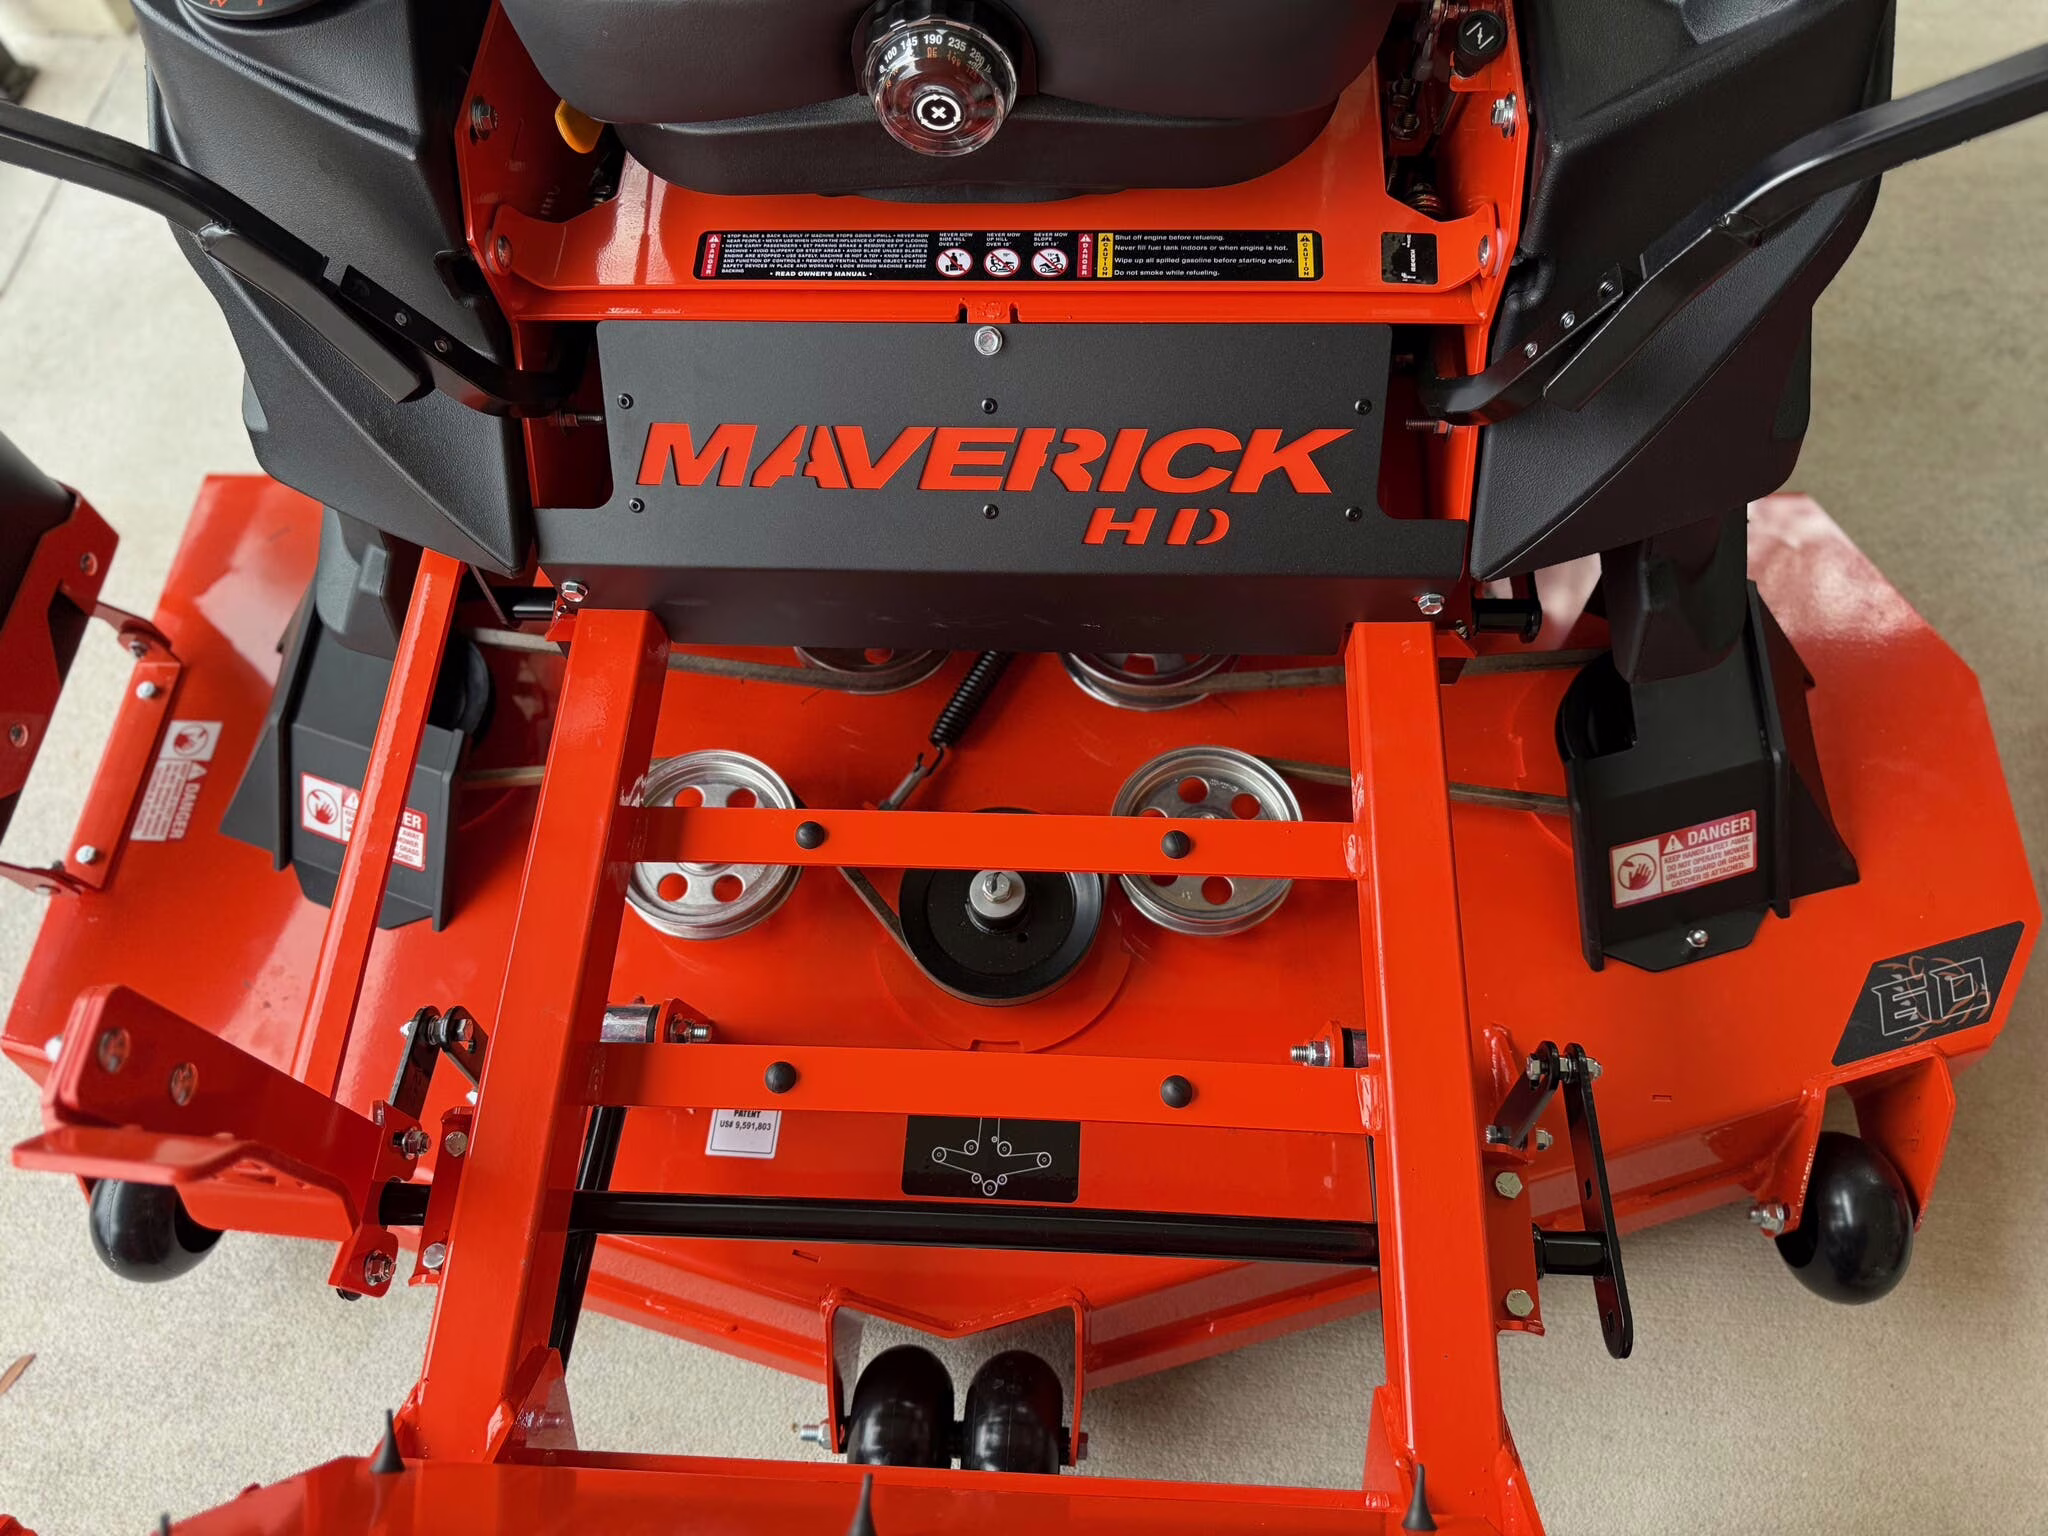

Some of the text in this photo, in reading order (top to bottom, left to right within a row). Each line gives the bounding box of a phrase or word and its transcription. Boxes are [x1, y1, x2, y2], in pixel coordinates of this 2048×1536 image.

[884, 46, 898, 63] 100
[900, 36, 918, 50] 145
[924, 34, 942, 44] 190
[948, 37, 966, 52] 235
[970, 48, 984, 64] 280
[706, 243, 716, 274] DANGER
[636, 422, 1356, 494] MAVERICK
[1081, 507, 1230, 546] HD
[1688, 816, 1750, 846] DANGER
[1664, 854, 1681, 863] KEEP
[1682, 847, 1705, 858] HANDS
[1713, 841, 1728, 850] FEET
[1677, 860, 1691, 869] NOT
[1693, 852, 1722, 865] OPERATE
[1724, 846, 1749, 857] MOWER
[1665, 868, 1691, 880] UNLESS
[1693, 862, 1716, 873] GUARD
[1727, 853, 1751, 864] GRASS
[1671, 874, 1701, 886] CATCHER
[1710, 862, 1745, 876] ATTACHED.
[735, 1121, 771, 1131] 9,591,803
